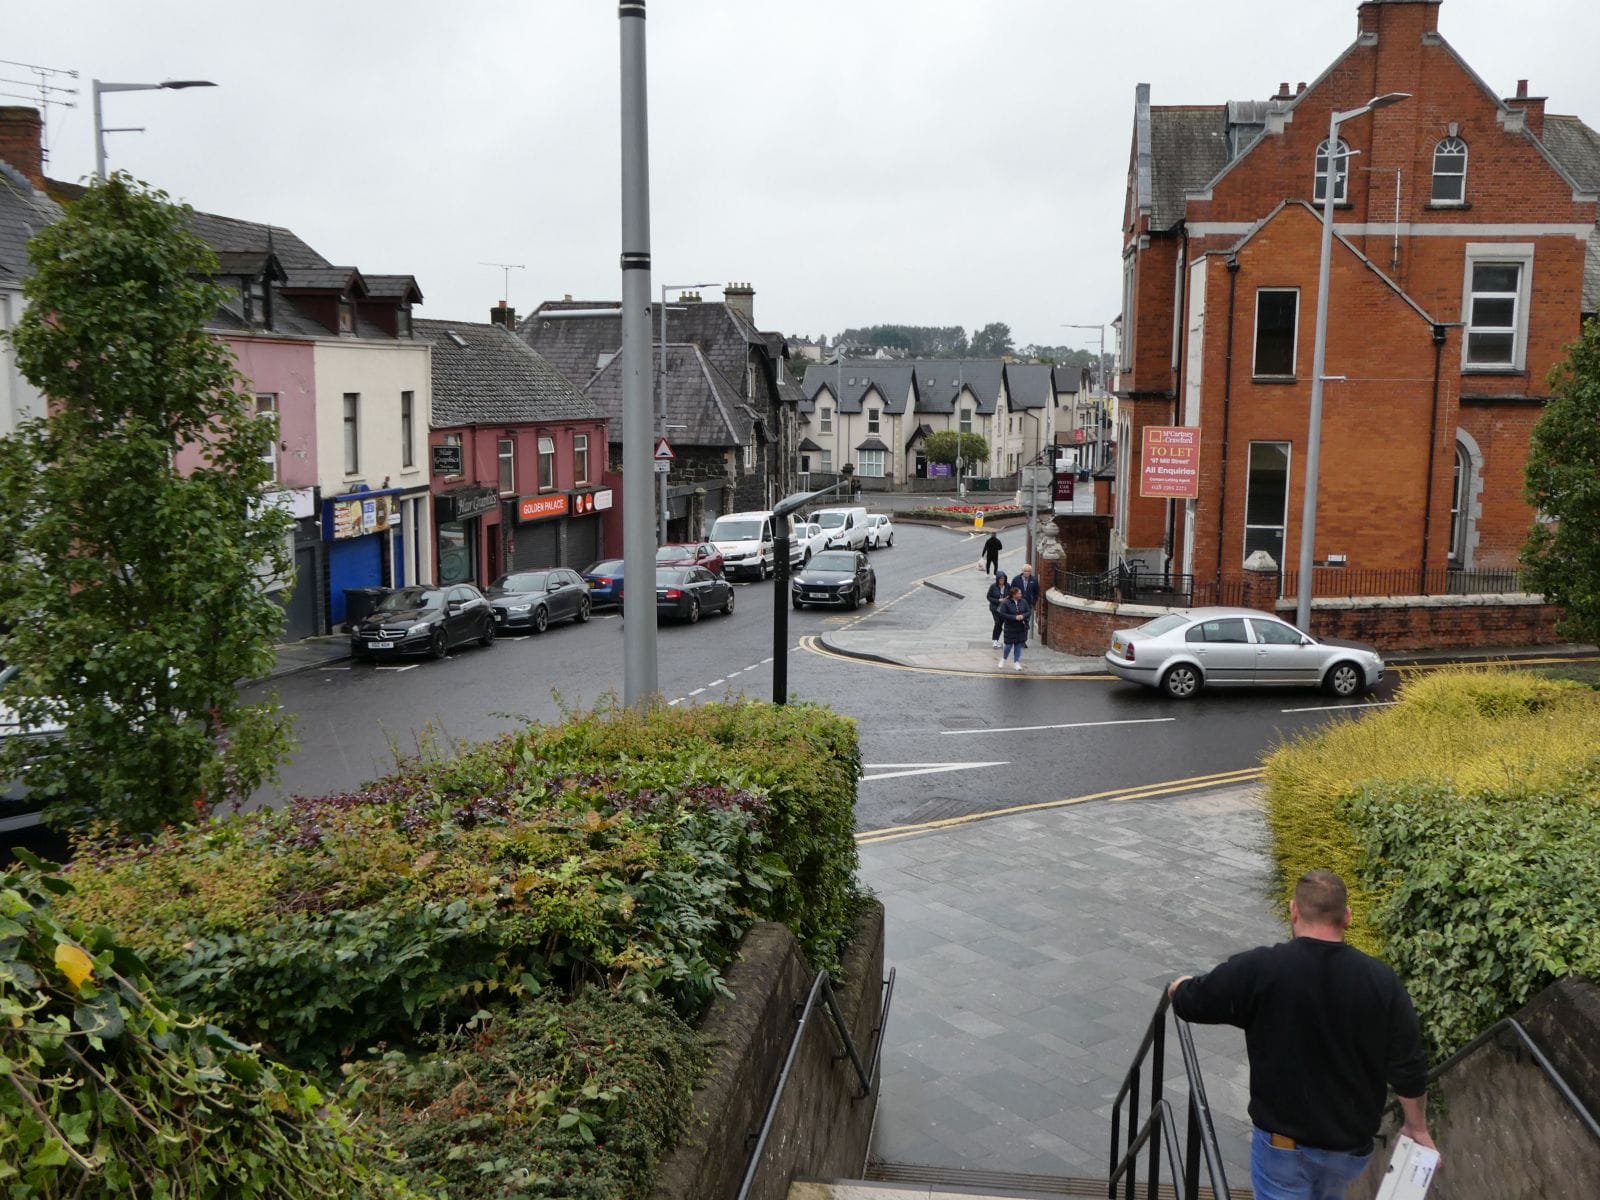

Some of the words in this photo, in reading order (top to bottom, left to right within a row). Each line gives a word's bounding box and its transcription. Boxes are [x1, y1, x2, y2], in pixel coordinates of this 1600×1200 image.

[1150, 447, 1167, 456] TO
[1170, 447, 1193, 457] LET
[1158, 467, 1196, 475] Enquiries
[458, 498, 472, 514] Hair
[473, 488, 497, 510] Graphics
[523, 502, 545, 515] GOLDEN
[544, 498, 564, 511] PALACE
